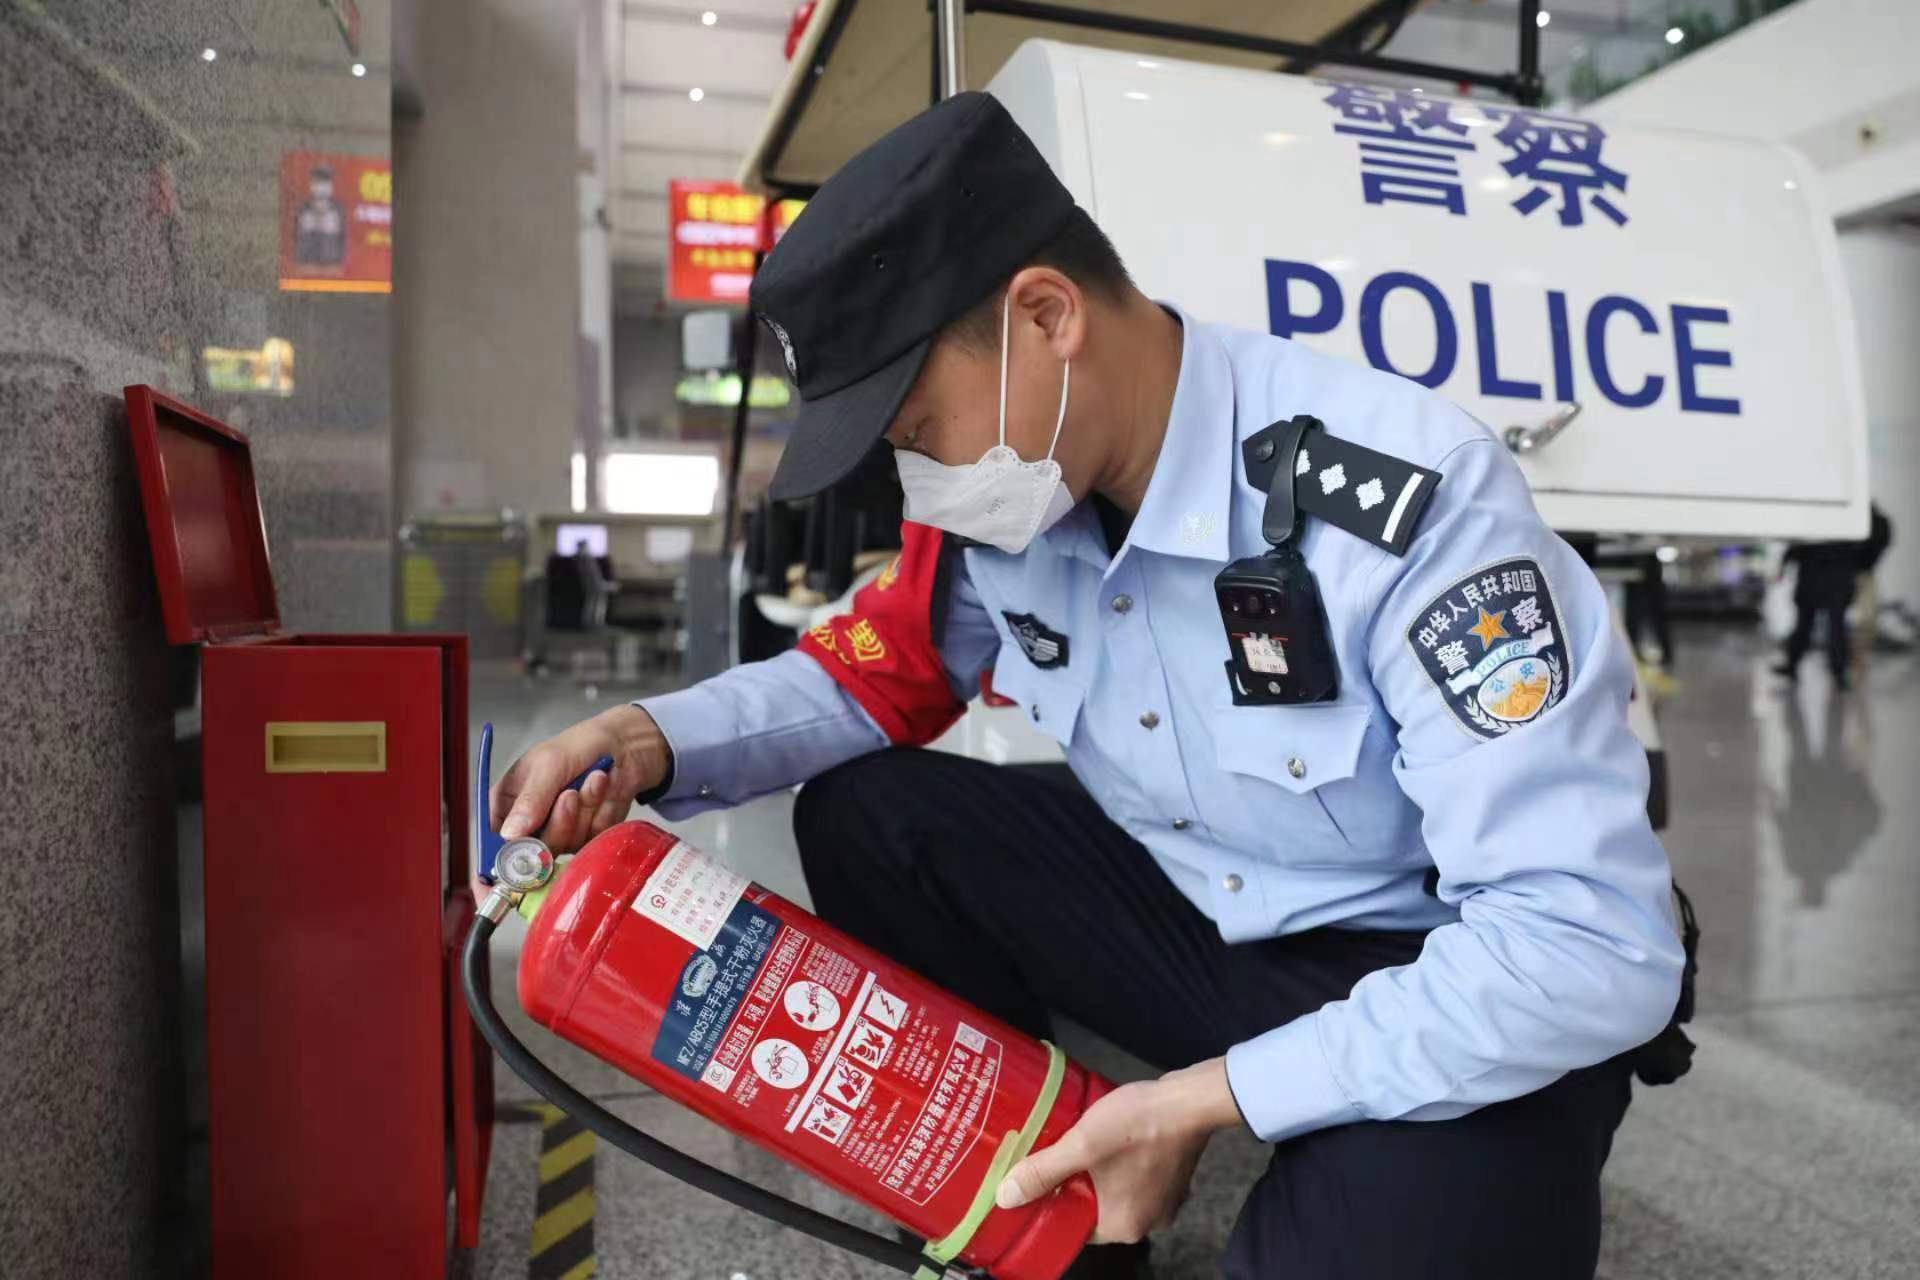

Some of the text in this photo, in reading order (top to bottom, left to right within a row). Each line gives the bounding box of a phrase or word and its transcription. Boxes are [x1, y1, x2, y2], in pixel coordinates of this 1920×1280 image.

[1322, 81, 1629, 228] 警察
[1264, 257, 1741, 416] POLICE
[1418, 569, 1537, 649] 中华人民共和国
[676, 914, 767, 1066] MFZ/ABC5型手提式干粉灭火器
